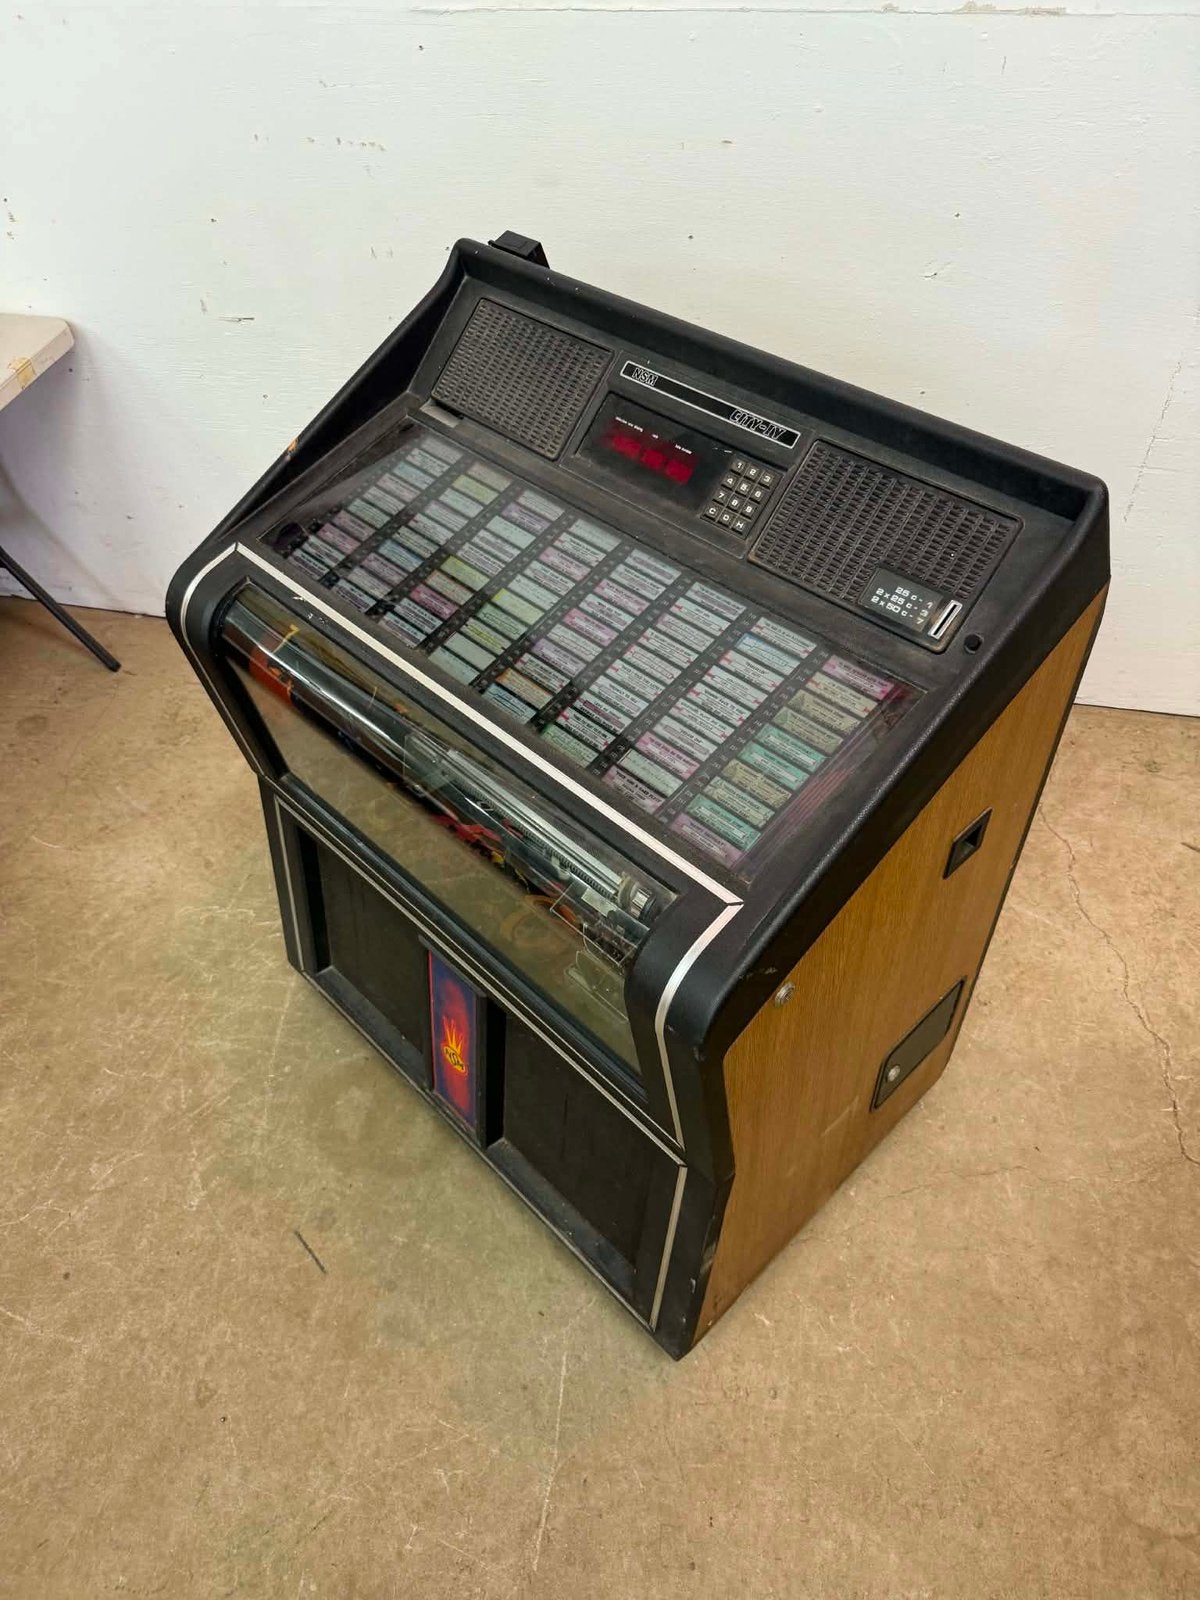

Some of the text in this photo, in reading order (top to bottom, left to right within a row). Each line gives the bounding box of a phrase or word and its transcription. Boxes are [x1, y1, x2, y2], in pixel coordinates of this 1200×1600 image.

[631, 367, 659, 386] NSM
[894, 586, 910, 597] 25
[890, 594, 906, 605] 25
[885, 602, 901, 613] 50
